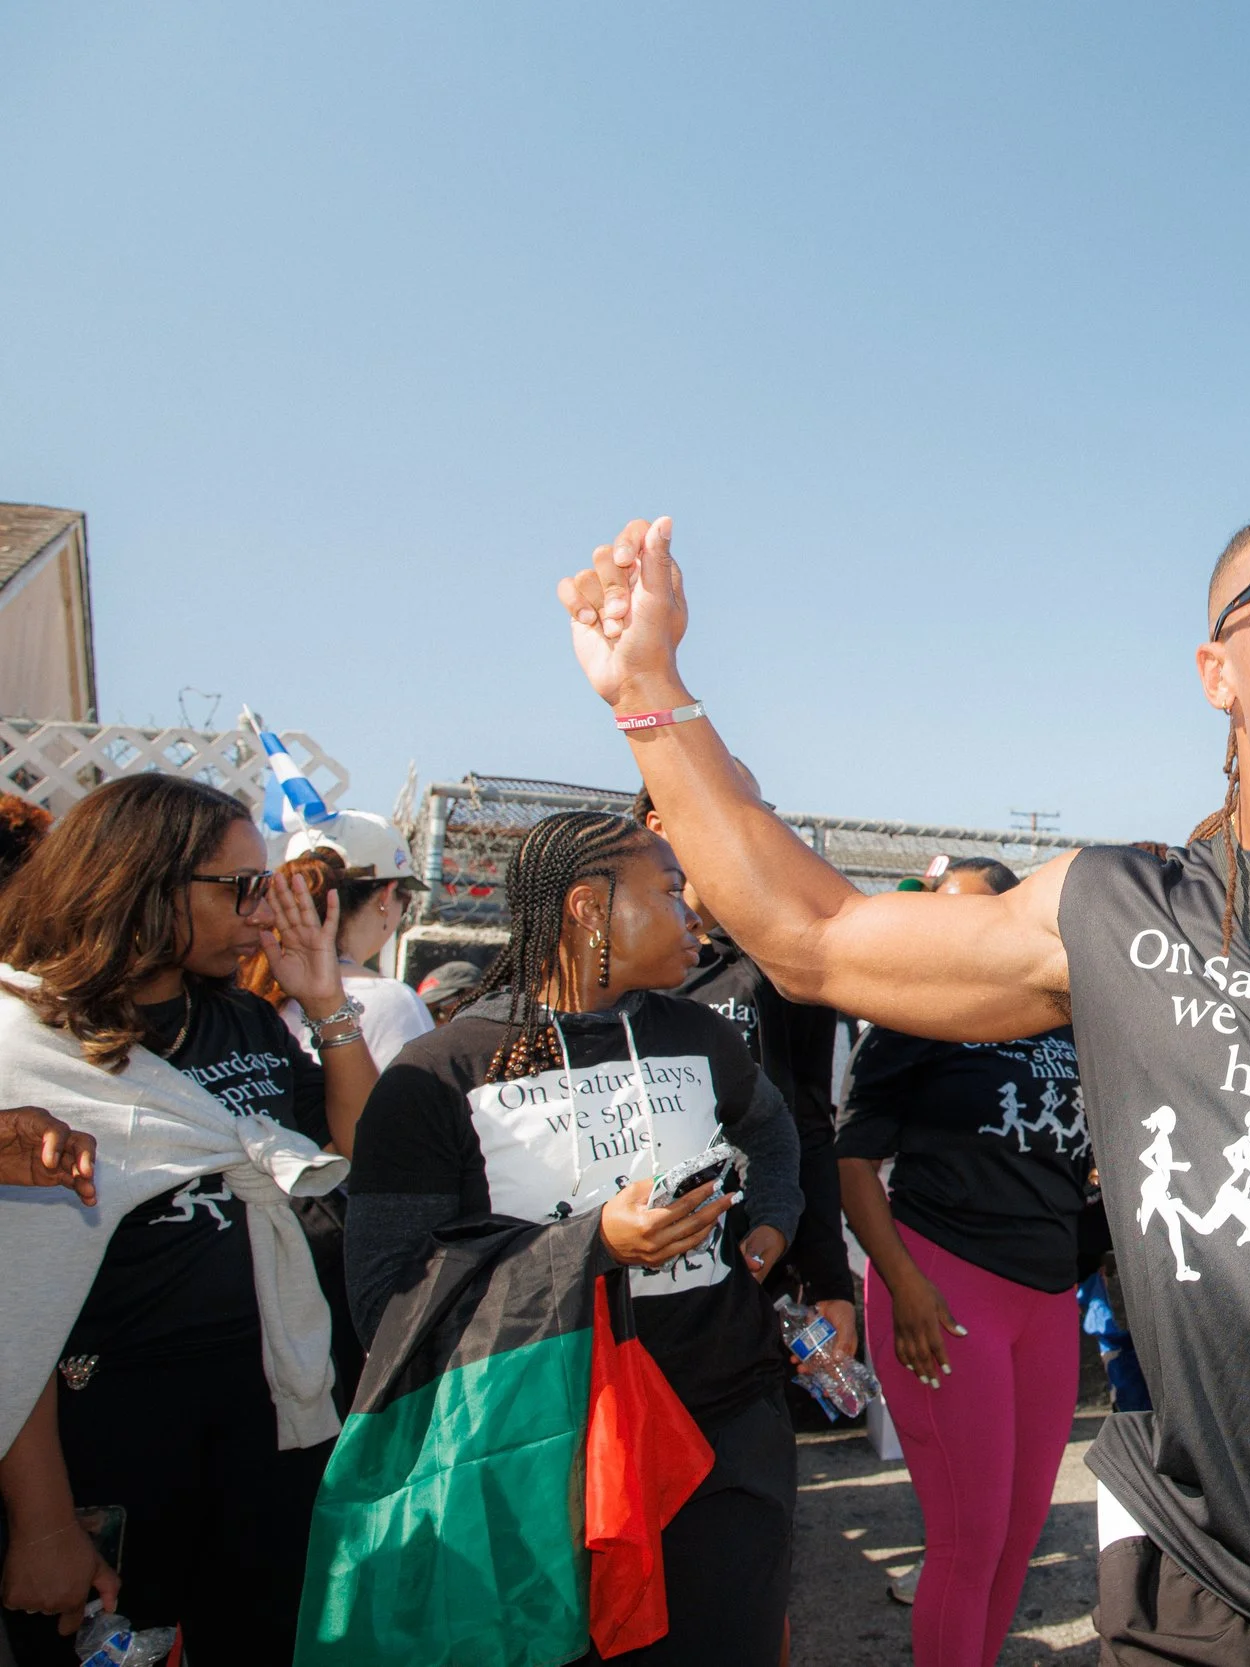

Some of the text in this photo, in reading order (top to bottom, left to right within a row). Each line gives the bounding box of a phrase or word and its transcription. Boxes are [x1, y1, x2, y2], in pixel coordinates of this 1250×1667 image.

[1130, 929, 1193, 976] On
[1171, 995, 1239, 1034] we
[498, 1062, 702, 1110] On Saturdays,
[1029, 1060, 1080, 1080] hills.
[546, 1093, 687, 1134] we sprint
[589, 1127, 662, 1161] hills.
